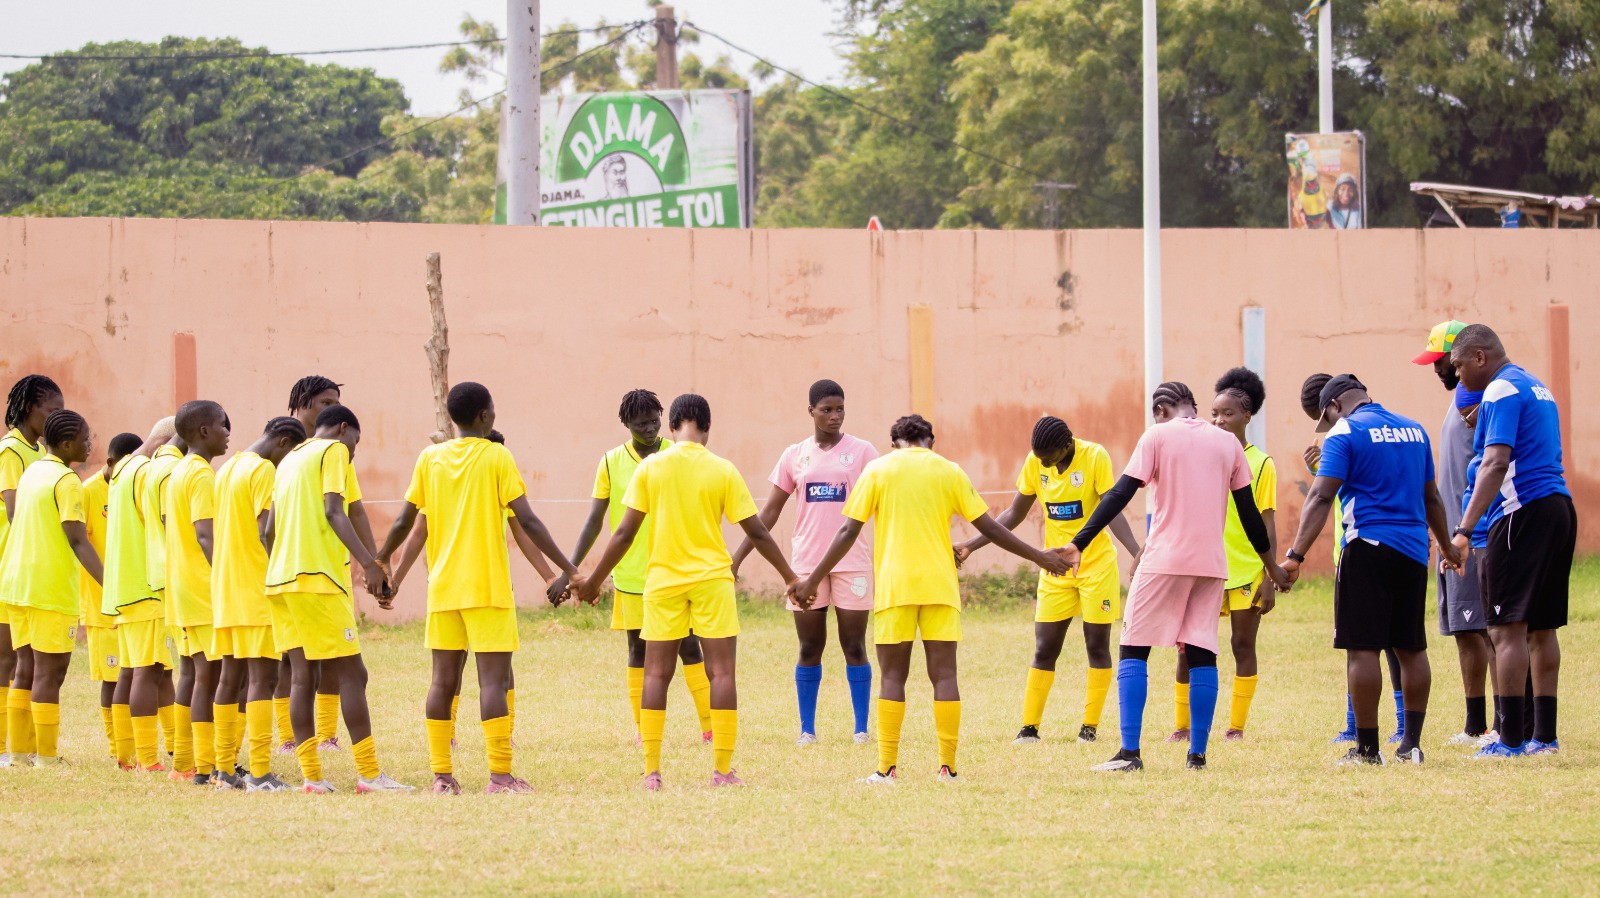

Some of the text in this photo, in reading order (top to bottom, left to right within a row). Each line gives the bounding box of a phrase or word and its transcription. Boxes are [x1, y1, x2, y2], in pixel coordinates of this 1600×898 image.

[569, 103, 675, 172] DJAMA
[1368, 424, 1425, 444] BÉNIN
[1048, 503, 1079, 515] 1XBET
